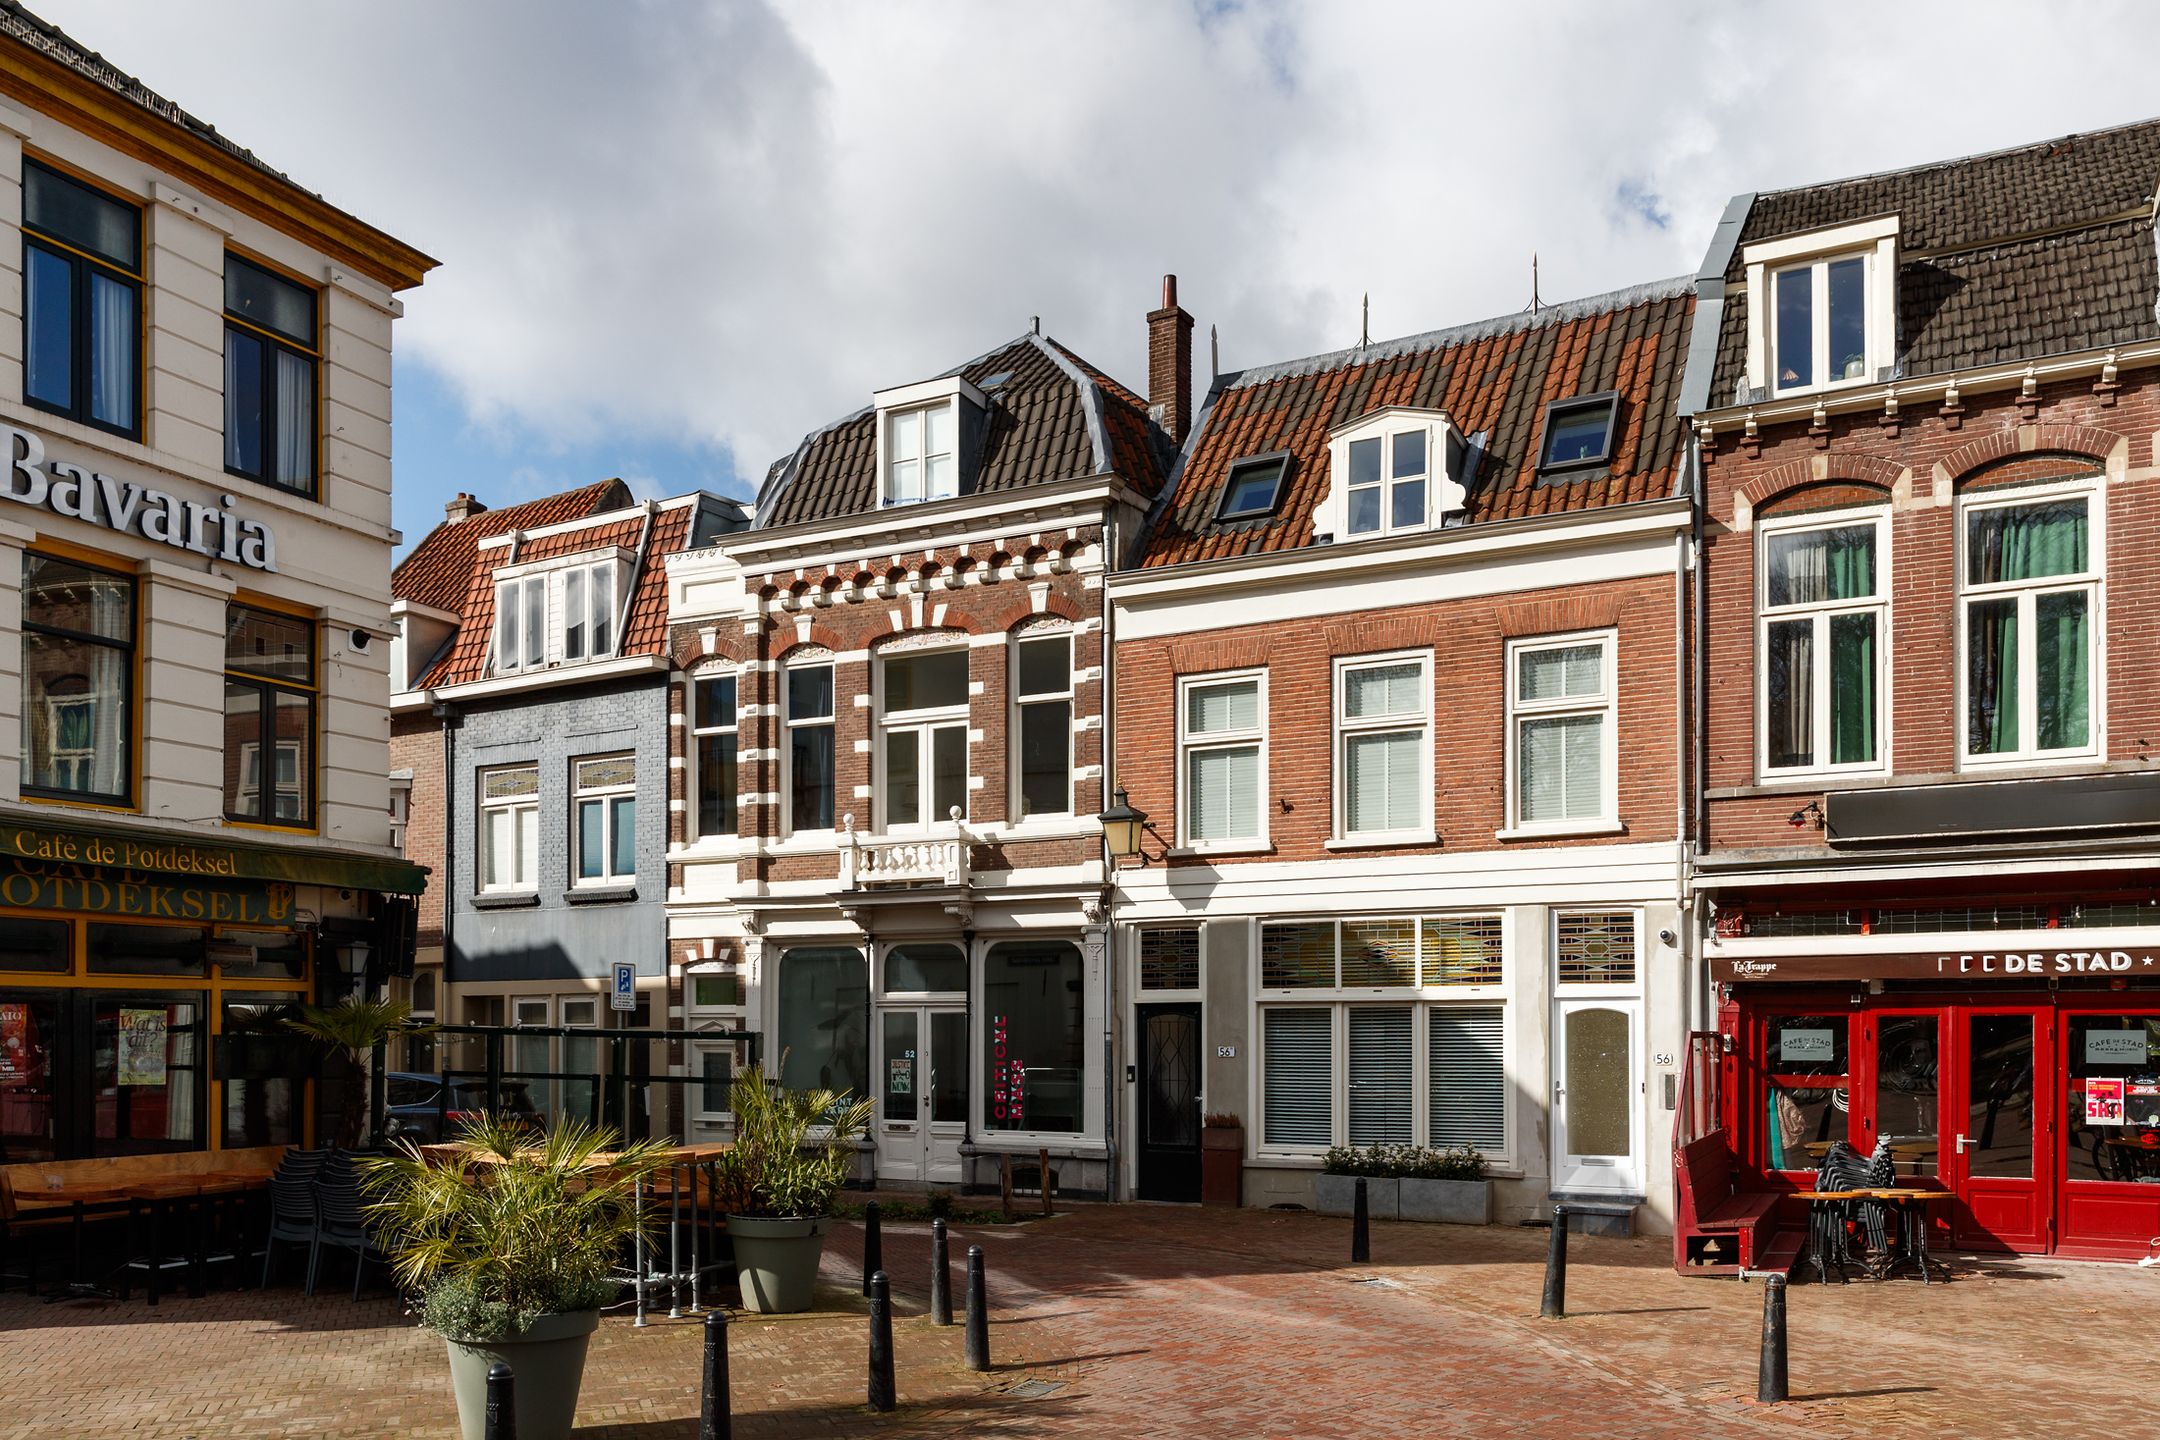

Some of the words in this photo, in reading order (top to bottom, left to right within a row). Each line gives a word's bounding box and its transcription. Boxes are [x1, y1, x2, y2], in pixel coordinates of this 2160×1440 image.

[0, 423, 279, 573] Bavaria
[15, 830, 78, 860] Café
[86, 838, 115, 865] de
[125, 842, 238, 876] Potdeksel
[2005, 954, 2044, 973] DE
[2055, 952, 2133, 972] STAD
[620, 969, 629, 983] P
[120, 1015, 153, 1031] Wat
[154, 1015, 166, 1031] is
[128, 1031, 157, 1048] dit?
[2121, 1039, 2144, 1048] STAD
[904, 1050, 915, 1058] 52
[1656, 1054, 1670, 1064] 56
[994, 1015, 1007, 1120] CRITICAL
[1010, 1058, 1024, 1119] MASS
